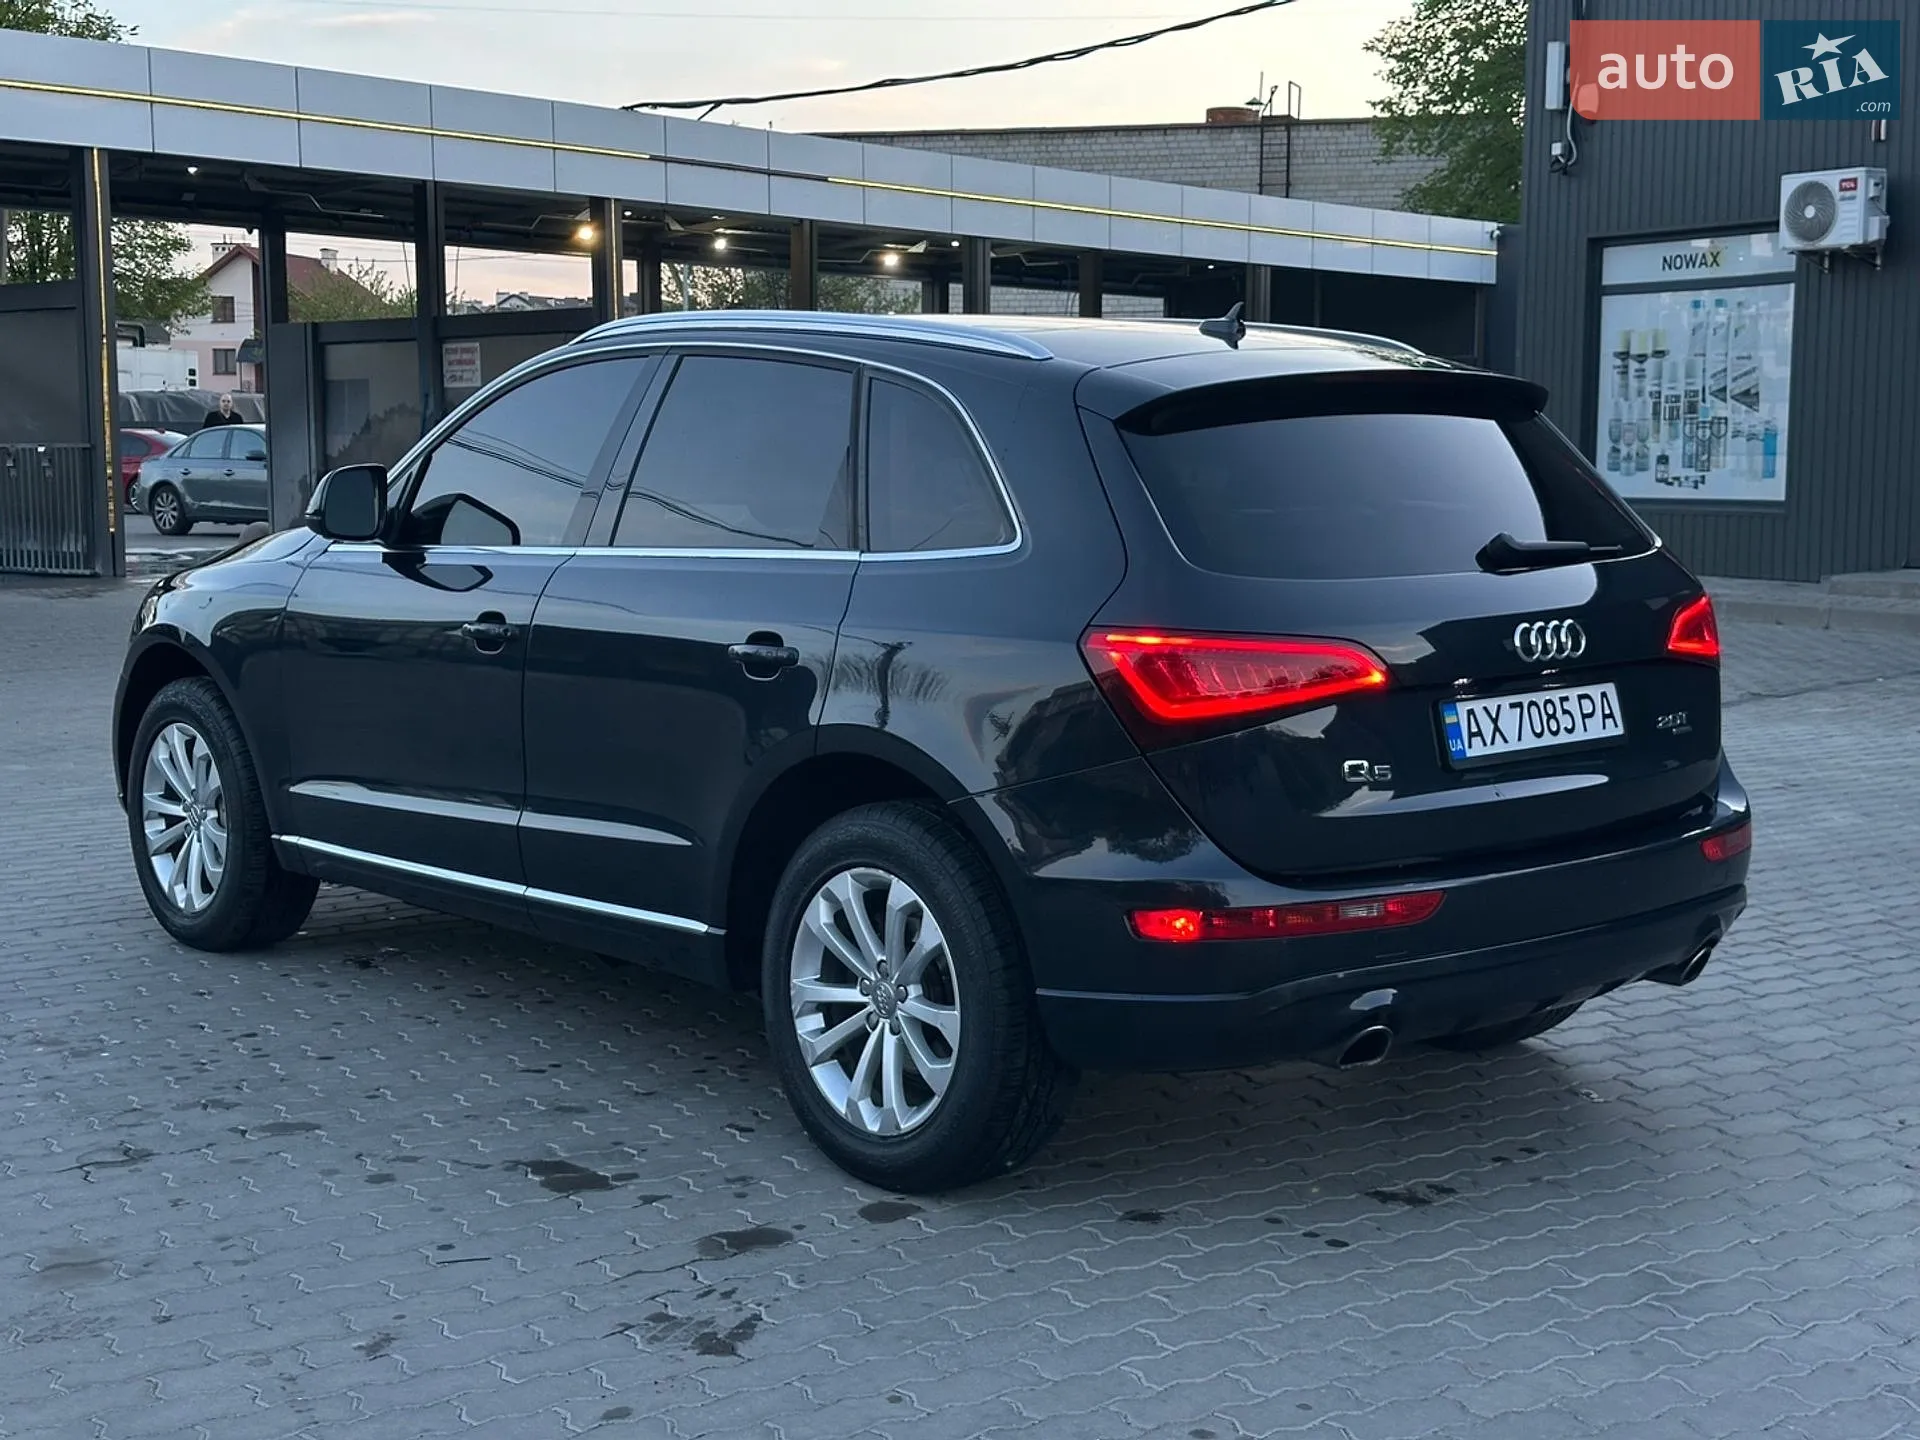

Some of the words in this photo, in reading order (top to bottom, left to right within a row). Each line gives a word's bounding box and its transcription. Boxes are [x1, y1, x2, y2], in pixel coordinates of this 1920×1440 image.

[1662, 252, 1721, 271] NOWAX
[1449, 739, 1464, 751] UA
[1343, 760, 1392, 782] Q5
